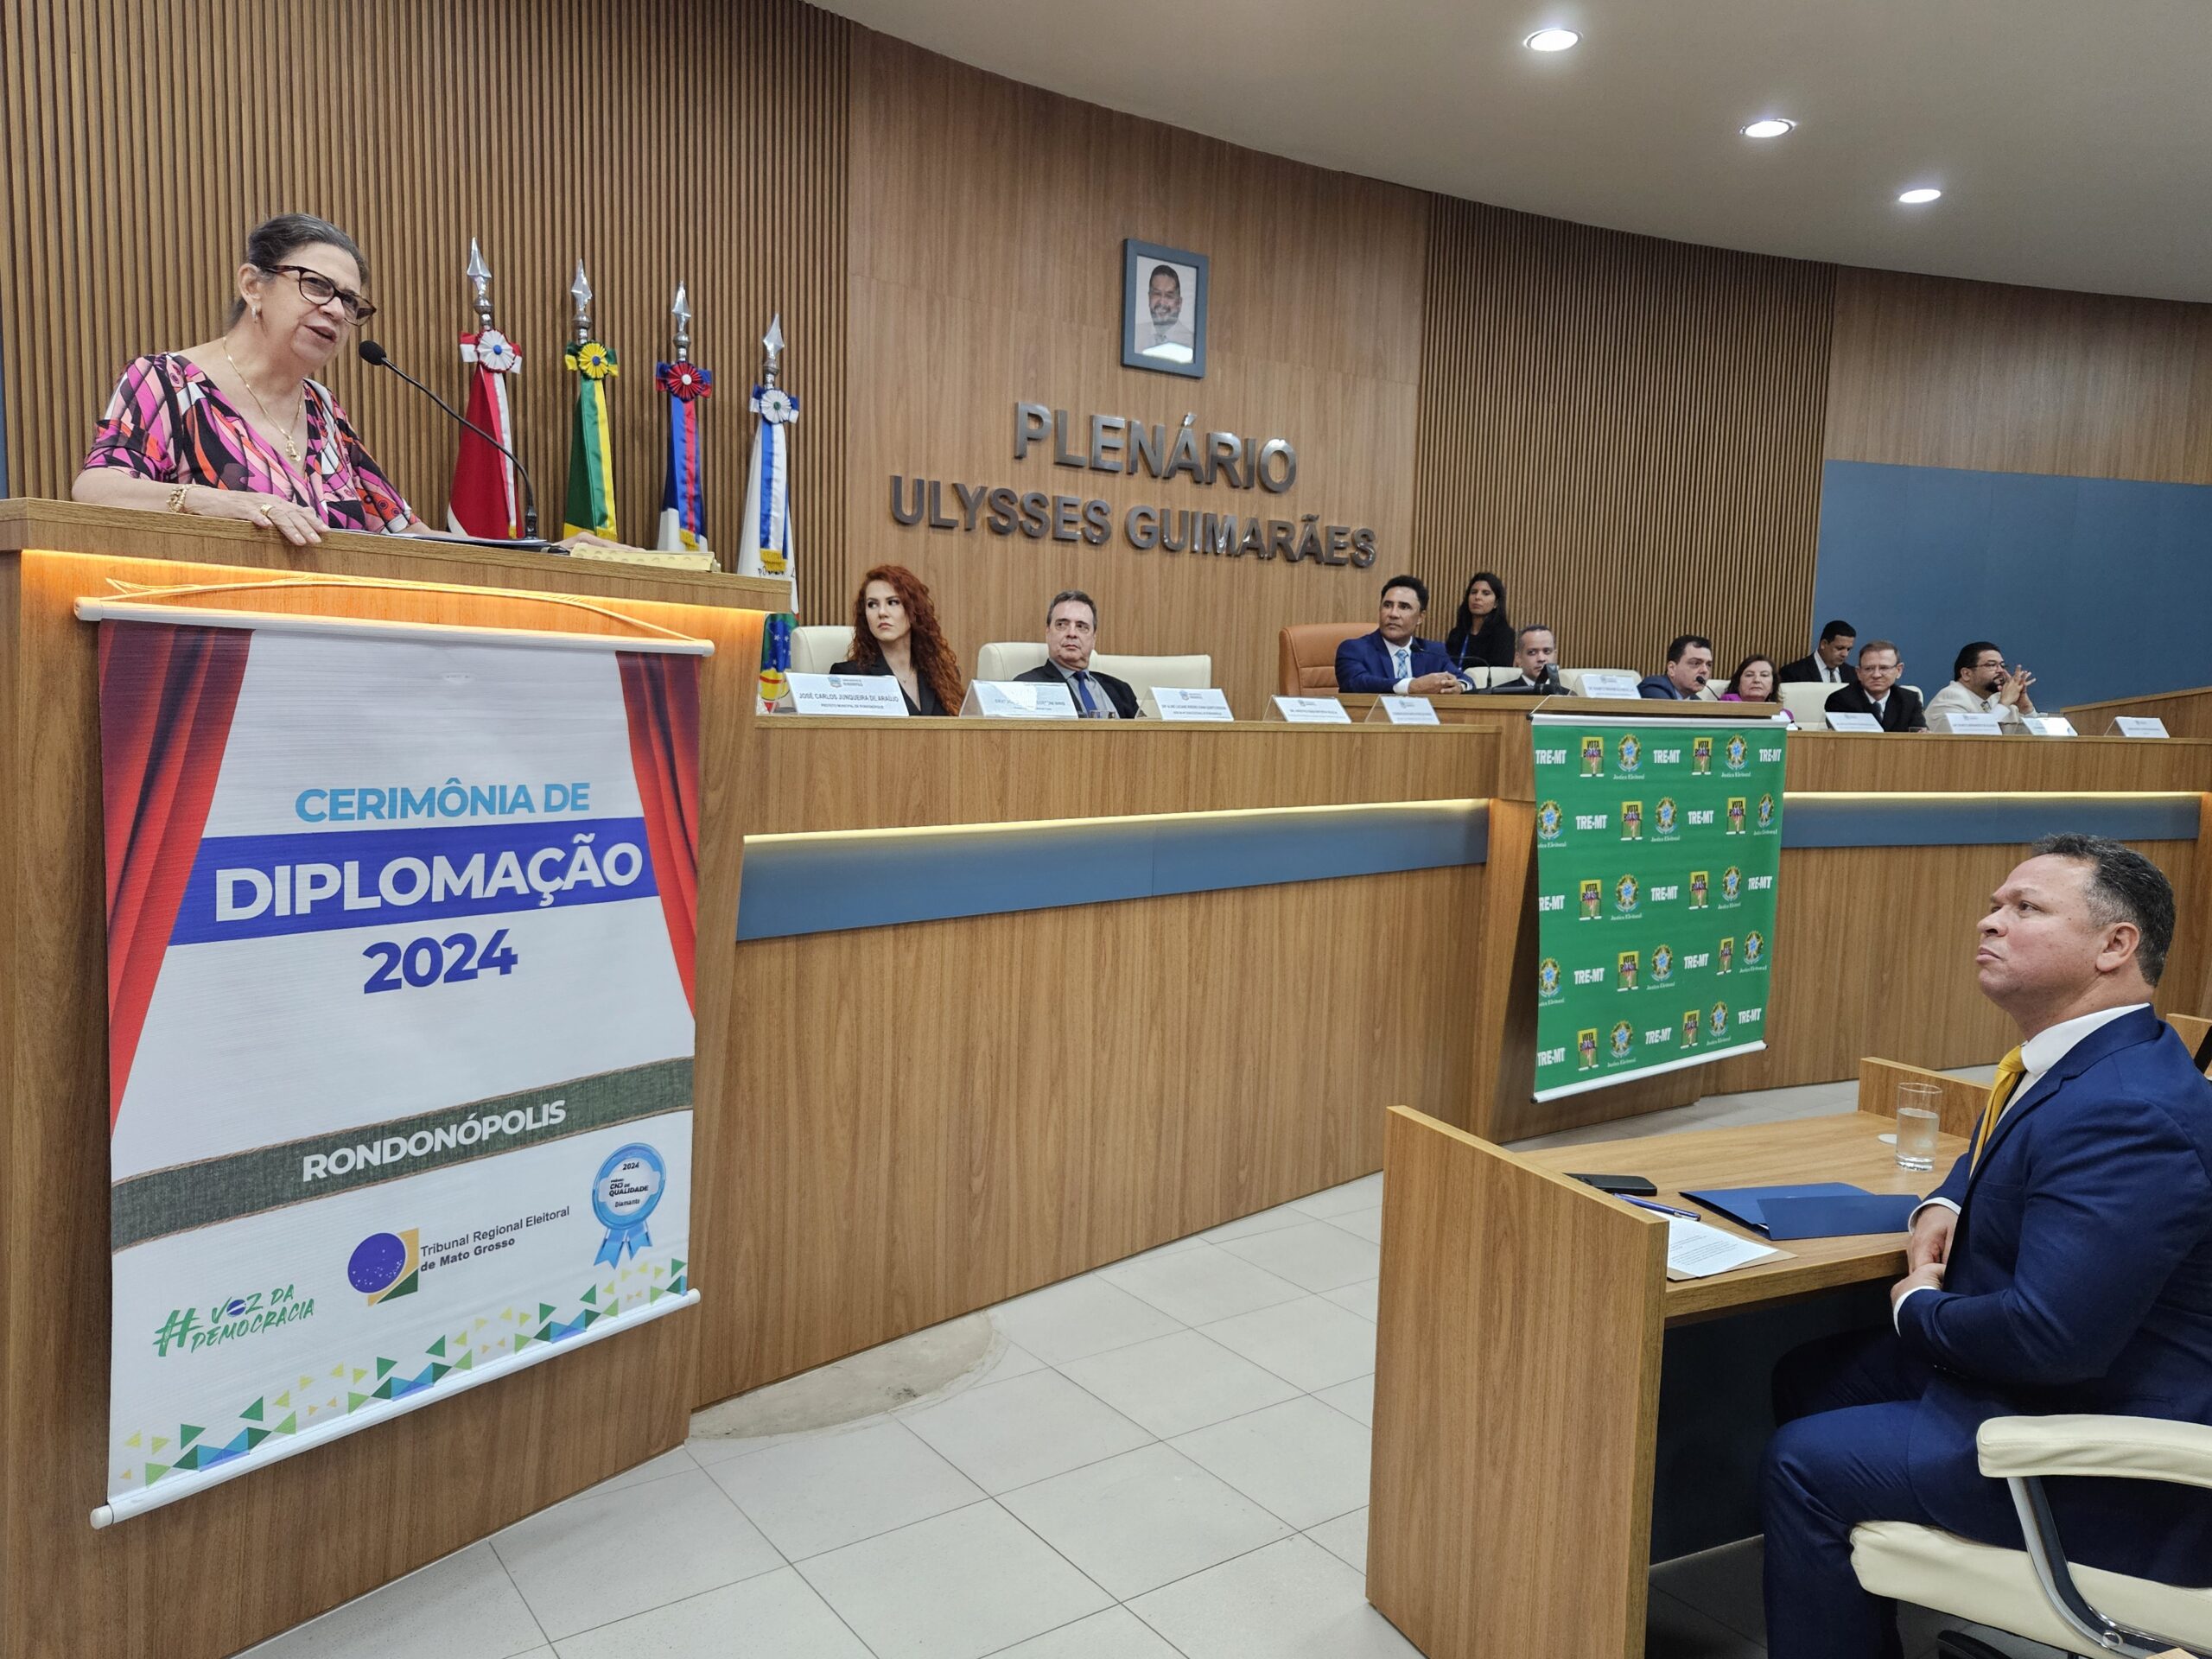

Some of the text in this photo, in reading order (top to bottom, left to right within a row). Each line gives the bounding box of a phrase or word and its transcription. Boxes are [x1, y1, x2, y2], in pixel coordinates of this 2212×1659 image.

[1014, 401, 1296, 493] PLENÁRIO
[890, 474, 1377, 568] ULYSSES GUIMARÃES
[296, 778, 590, 823] CERIMÔNIA DE
[215, 833, 643, 922] DIPLOMAÇÃO
[1538, 895, 1565, 912] RE-MT
[362, 929, 518, 994] 2024
[302, 1100, 566, 1182] RONDONÓPOLIS
[622, 1161, 639, 1171] 2024
[609, 1185, 649, 1197] QUALIDADE
[615, 1198, 640, 1208] Diamante
[421, 1205, 570, 1256] Tribunal Regional Eleitoral
[421, 1237, 516, 1272] de Mato Grosso
[191, 1299, 315, 1353] DEMOCRACIA
[212, 1293, 264, 1324] VOZ
[270, 1284, 294, 1306] DA
